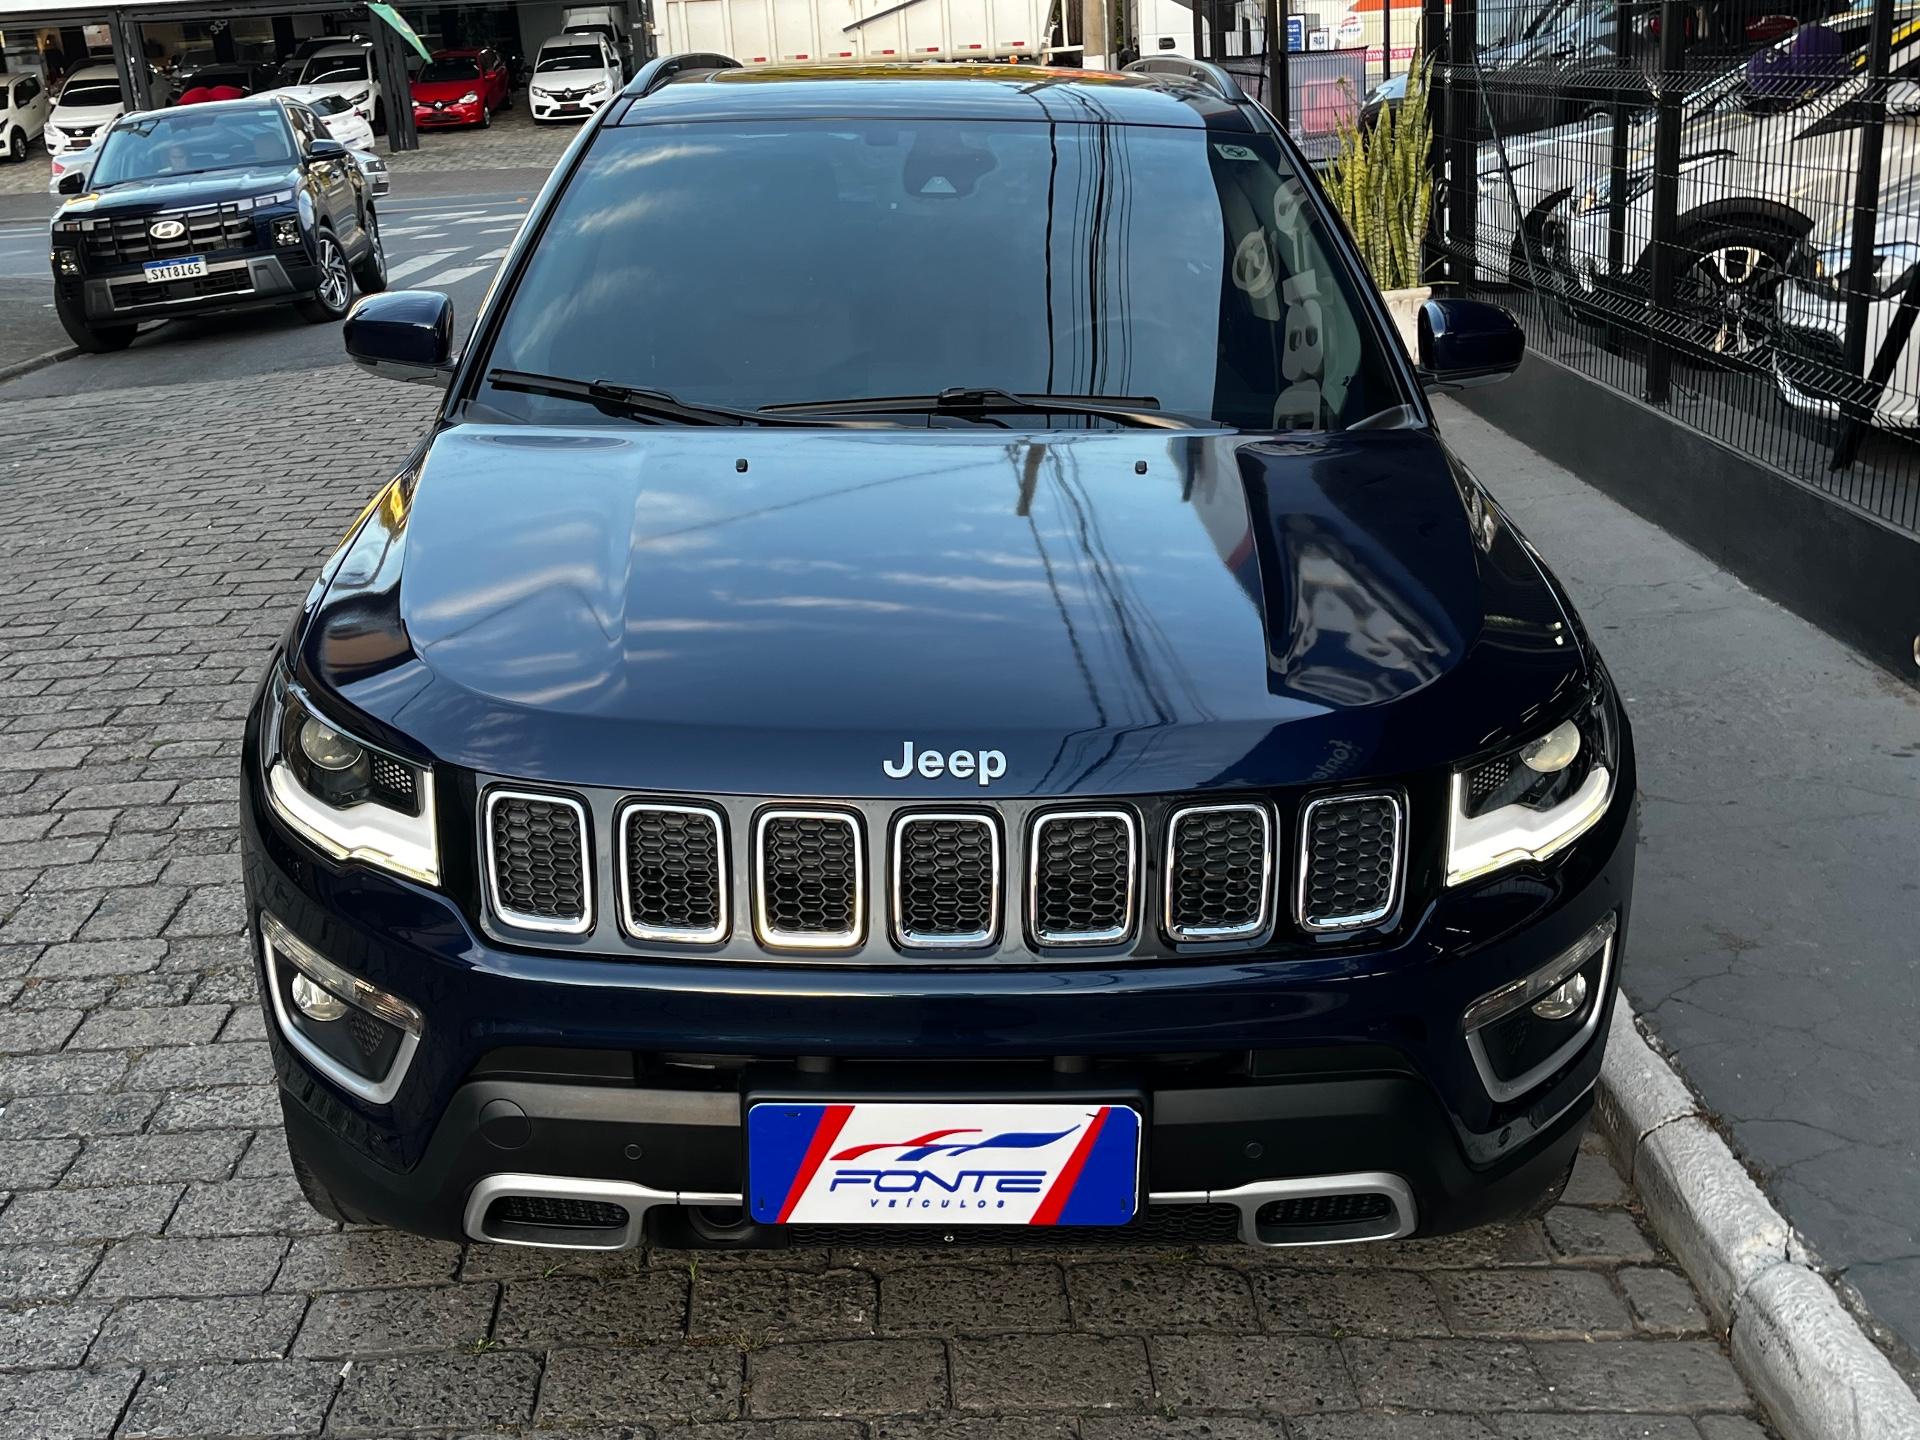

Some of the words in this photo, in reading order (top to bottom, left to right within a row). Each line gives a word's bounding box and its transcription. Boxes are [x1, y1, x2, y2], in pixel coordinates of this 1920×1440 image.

[883, 741, 1007, 786] Jeep
[829, 1169, 1047, 1193] FONTE
[870, 1197, 1005, 1208] VEÍCULOS
